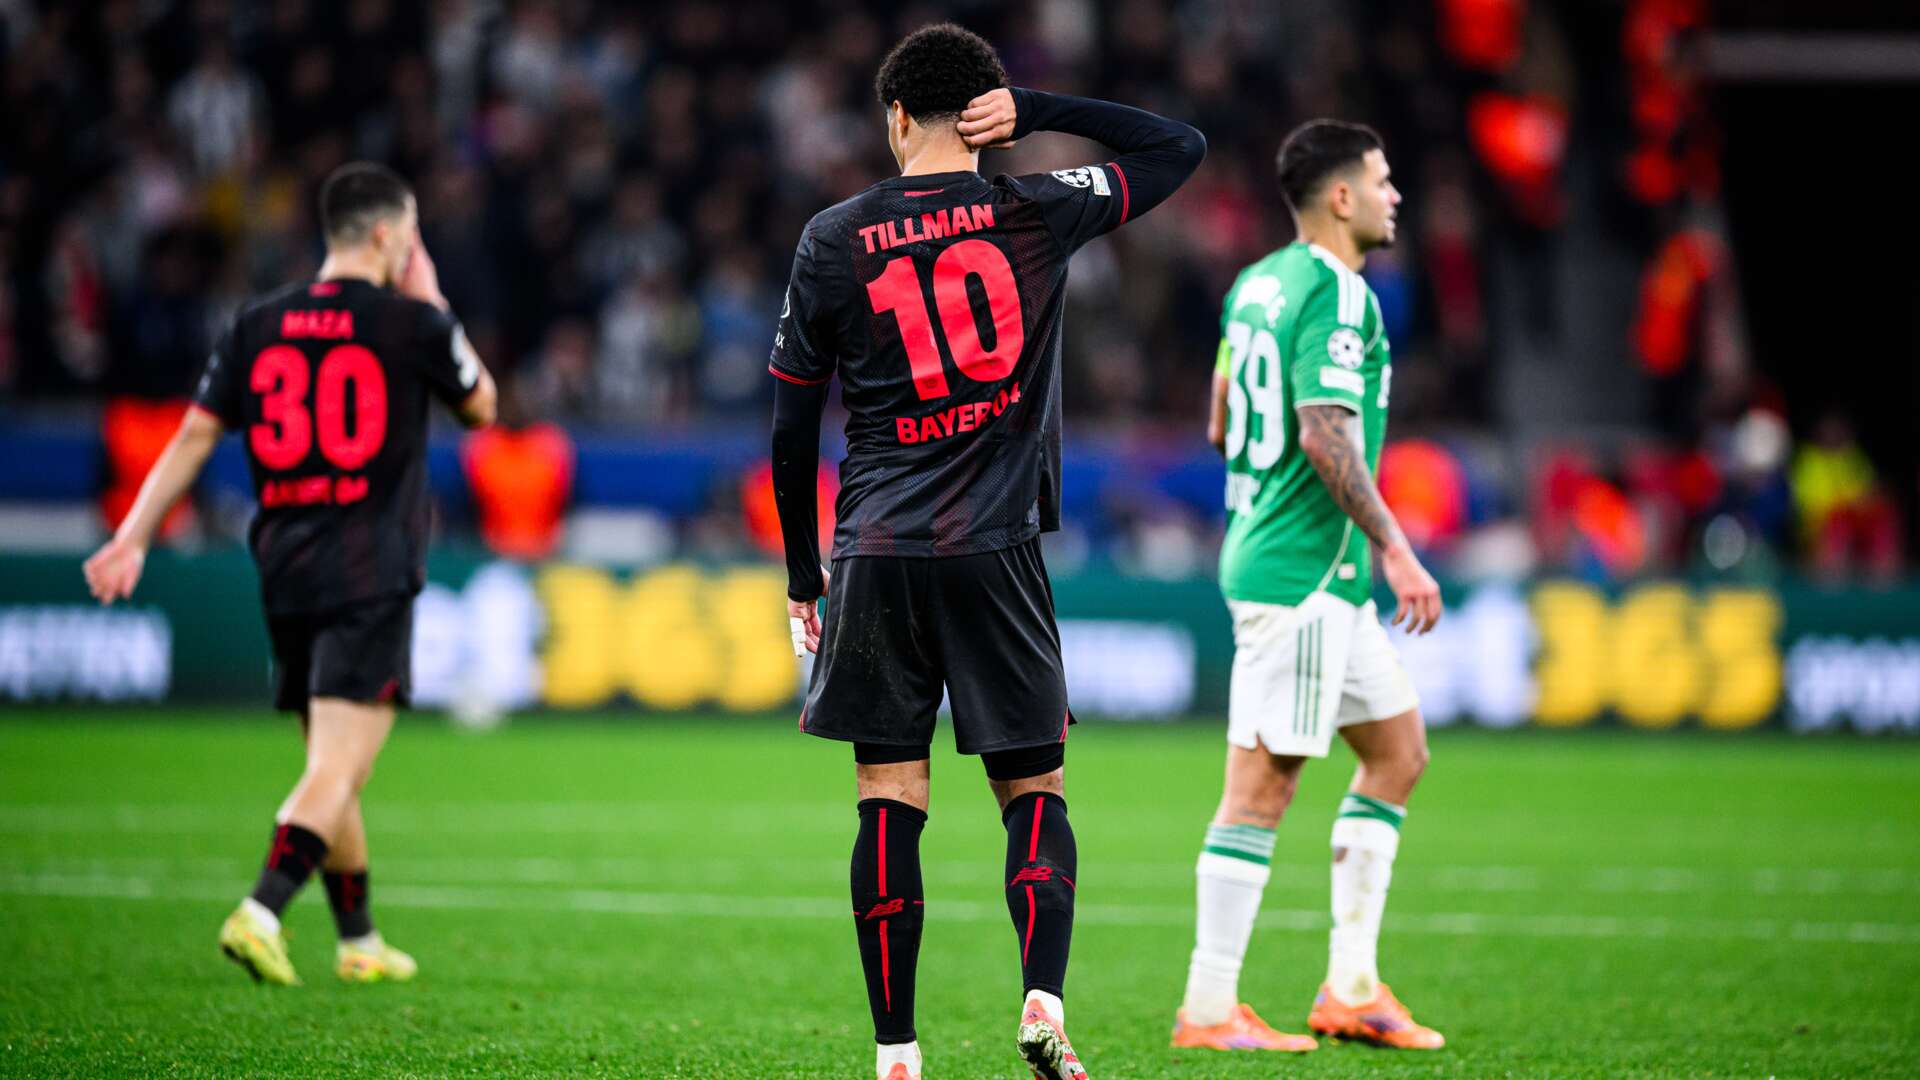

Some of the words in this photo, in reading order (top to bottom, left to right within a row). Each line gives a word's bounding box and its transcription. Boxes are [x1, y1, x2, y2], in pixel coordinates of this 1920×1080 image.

[858, 204, 996, 254] TILLMAN
[865, 239, 1025, 401] 10
[250, 344, 388, 470] 30
